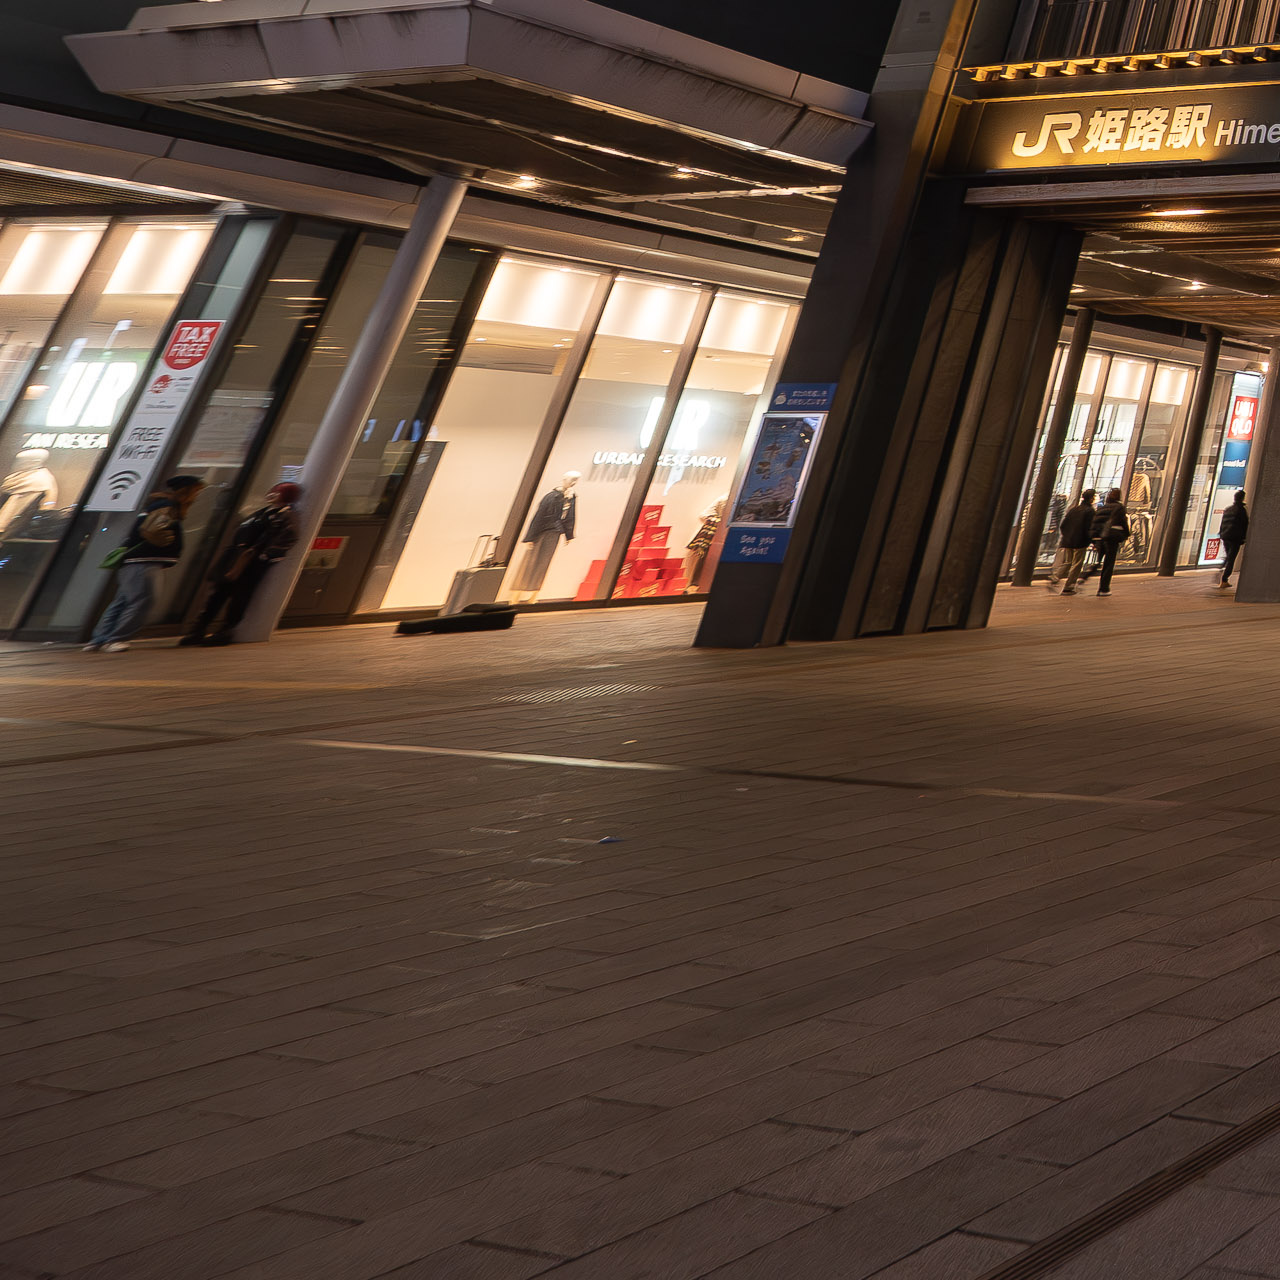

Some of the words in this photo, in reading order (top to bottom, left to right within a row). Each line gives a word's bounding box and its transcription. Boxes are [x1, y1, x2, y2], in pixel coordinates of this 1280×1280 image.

[177, 326, 216, 343] TAX
[168, 343, 209, 357] FREE
[127, 427, 166, 442] FREE
[739, 534, 757, 544] See
[758, 536, 776, 546] you
[1208, 540, 1220, 549] TAX
